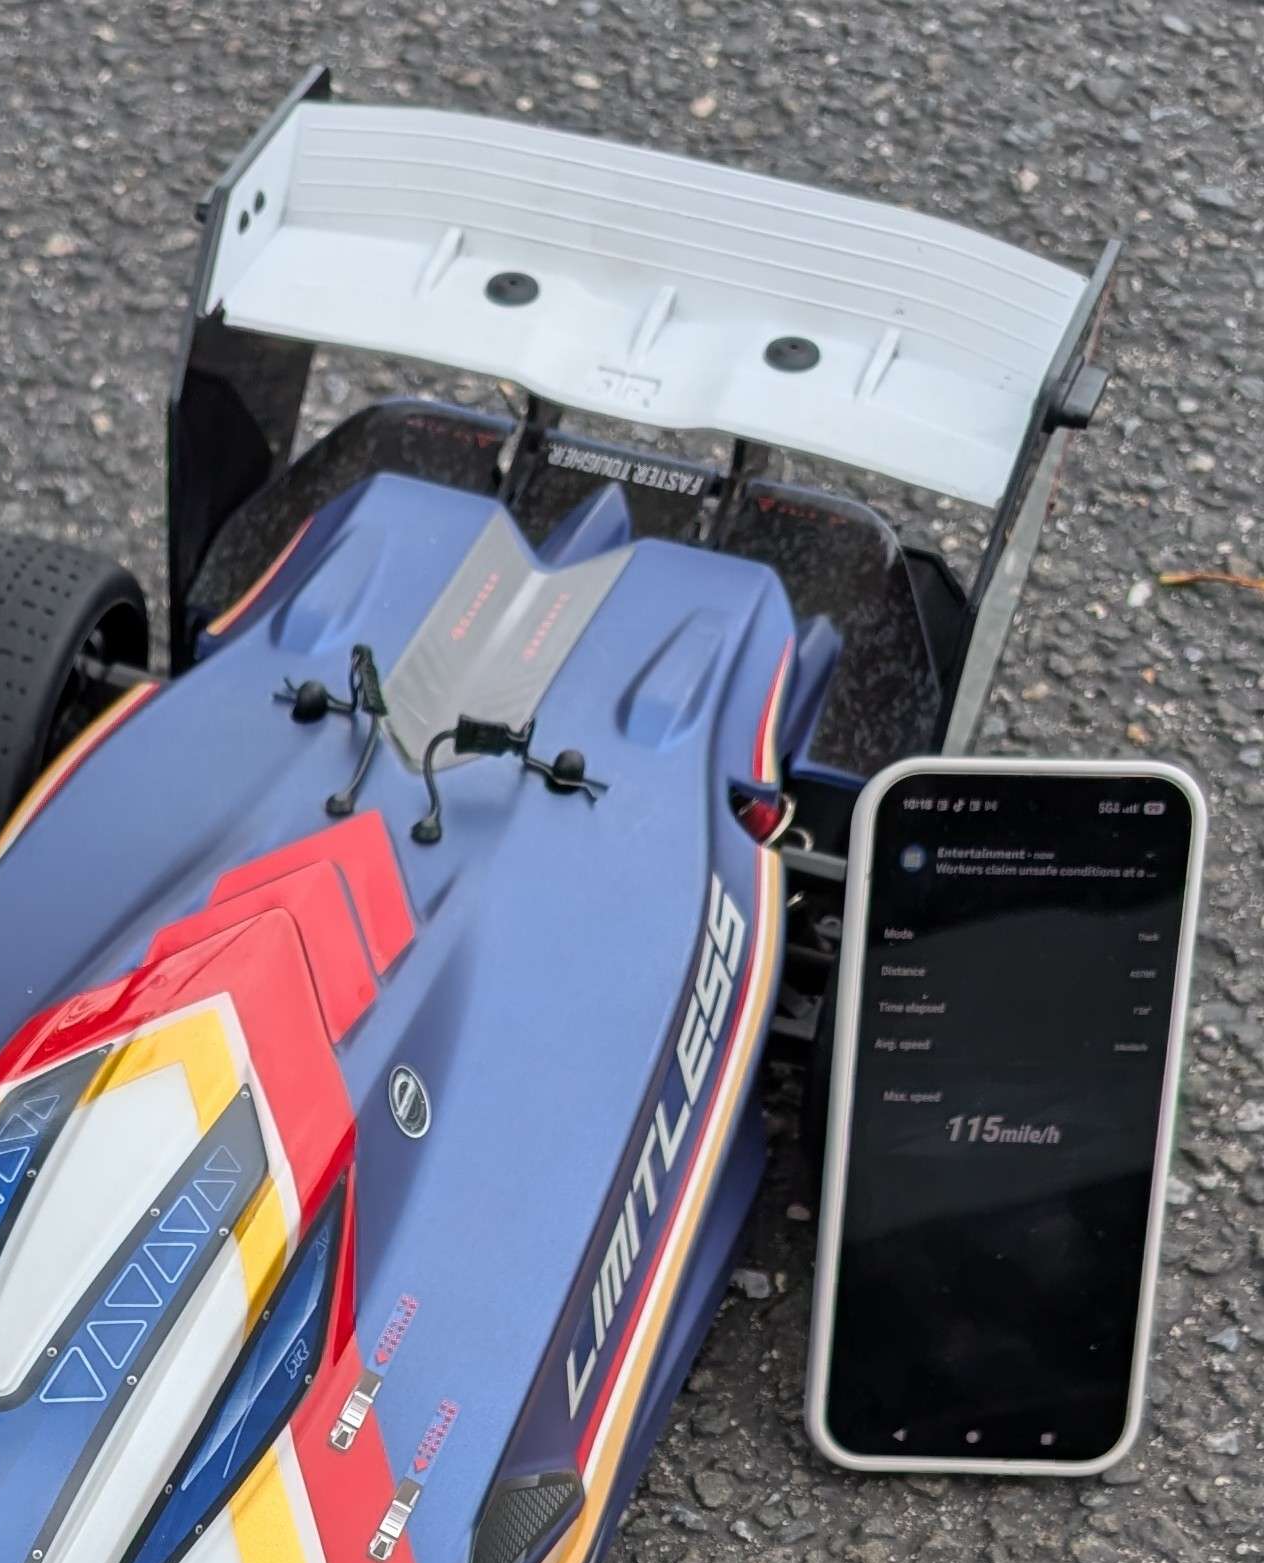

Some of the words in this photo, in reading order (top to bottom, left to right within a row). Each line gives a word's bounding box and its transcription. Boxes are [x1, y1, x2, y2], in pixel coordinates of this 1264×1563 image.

[937, 847, 1026, 861] Entertainment
[936, 863, 983, 876] Workers
[986, 864, 1017, 876] claim
[1019, 865, 1058, 877] unsafe
[1059, 867, 1121, 879] conditions
[884, 928, 914, 940] Mode
[881, 966, 925, 977] Distance
[880, 1002, 903, 1013] Time
[905, 1003, 945, 1015] elapsed
[899, 1039, 931, 1052] speed
[910, 1092, 942, 1103] speed
[567, 873, 746, 1419] LIMITLESS
